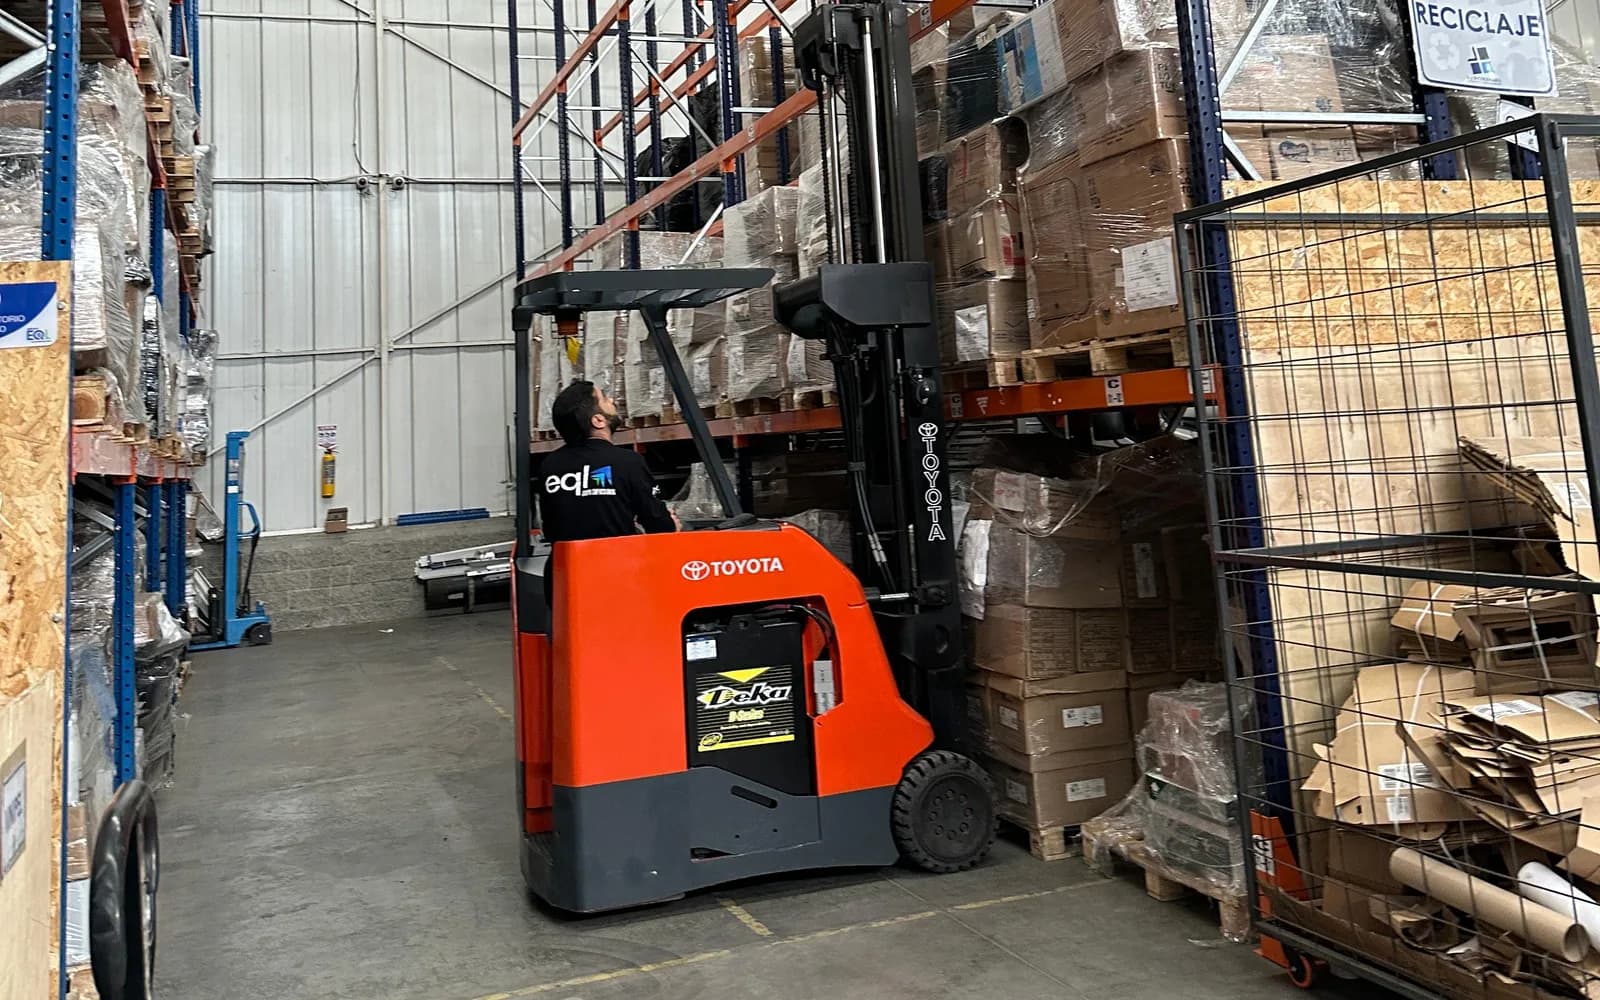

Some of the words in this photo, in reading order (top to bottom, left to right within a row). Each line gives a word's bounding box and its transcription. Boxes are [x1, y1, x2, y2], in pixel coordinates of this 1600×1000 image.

[1415, 2, 1540, 37] RECICLAJE
[26, 329, 52, 341] EQL
[1107, 379, 1120, 389] C
[545, 465, 590, 496] eql
[922, 437, 946, 541] TOYOTA
[710, 557, 784, 577] TOYOTA
[697, 682, 792, 709] Deka
